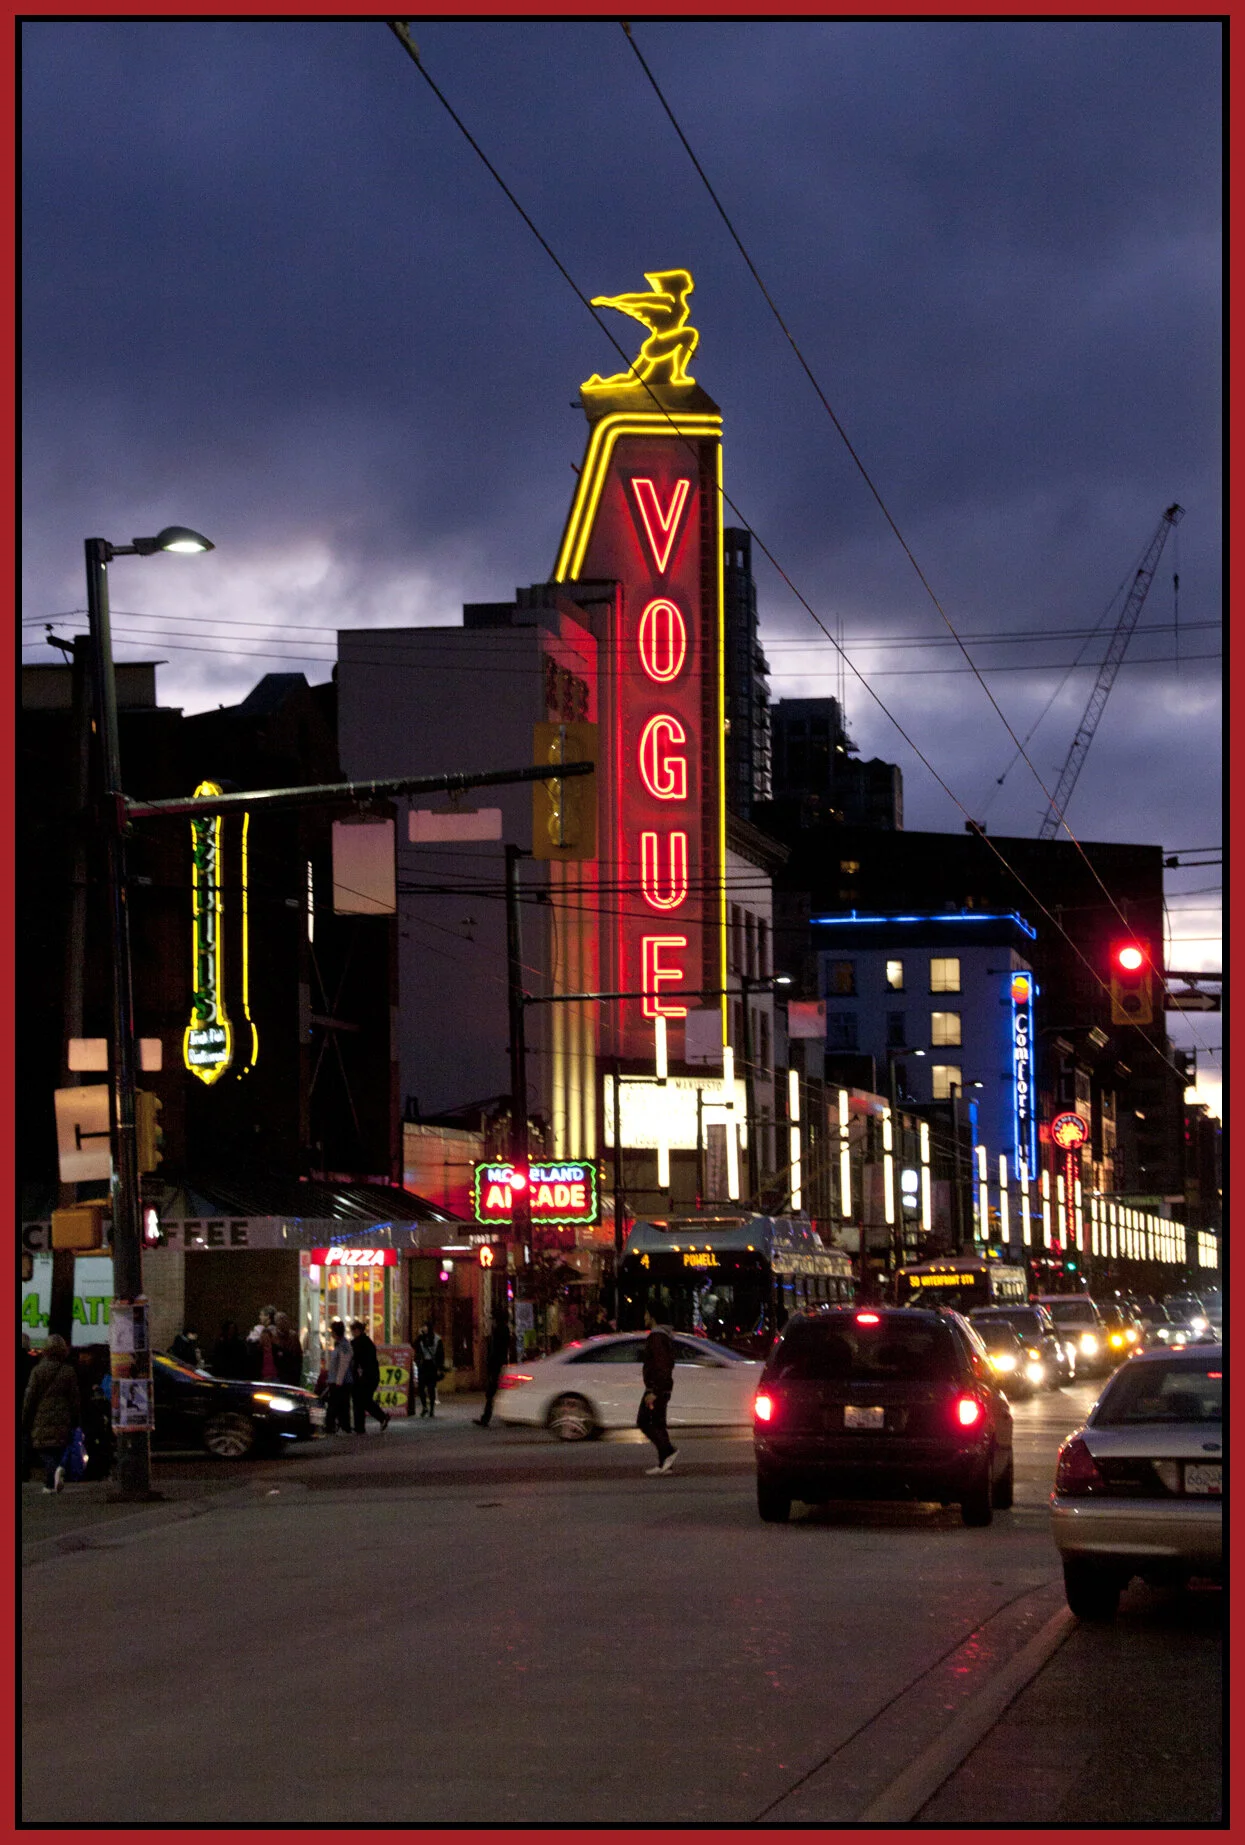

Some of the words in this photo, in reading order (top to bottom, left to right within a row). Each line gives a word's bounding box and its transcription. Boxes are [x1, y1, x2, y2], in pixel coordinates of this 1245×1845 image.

[631, 478, 691, 1019] VOGUE
[1014, 1013, 1028, 1118] Comfort
[325, 1247, 385, 1266] PIZZA
[640, 1254, 650, 1270] 4
[683, 1253, 718, 1267] POWELL
